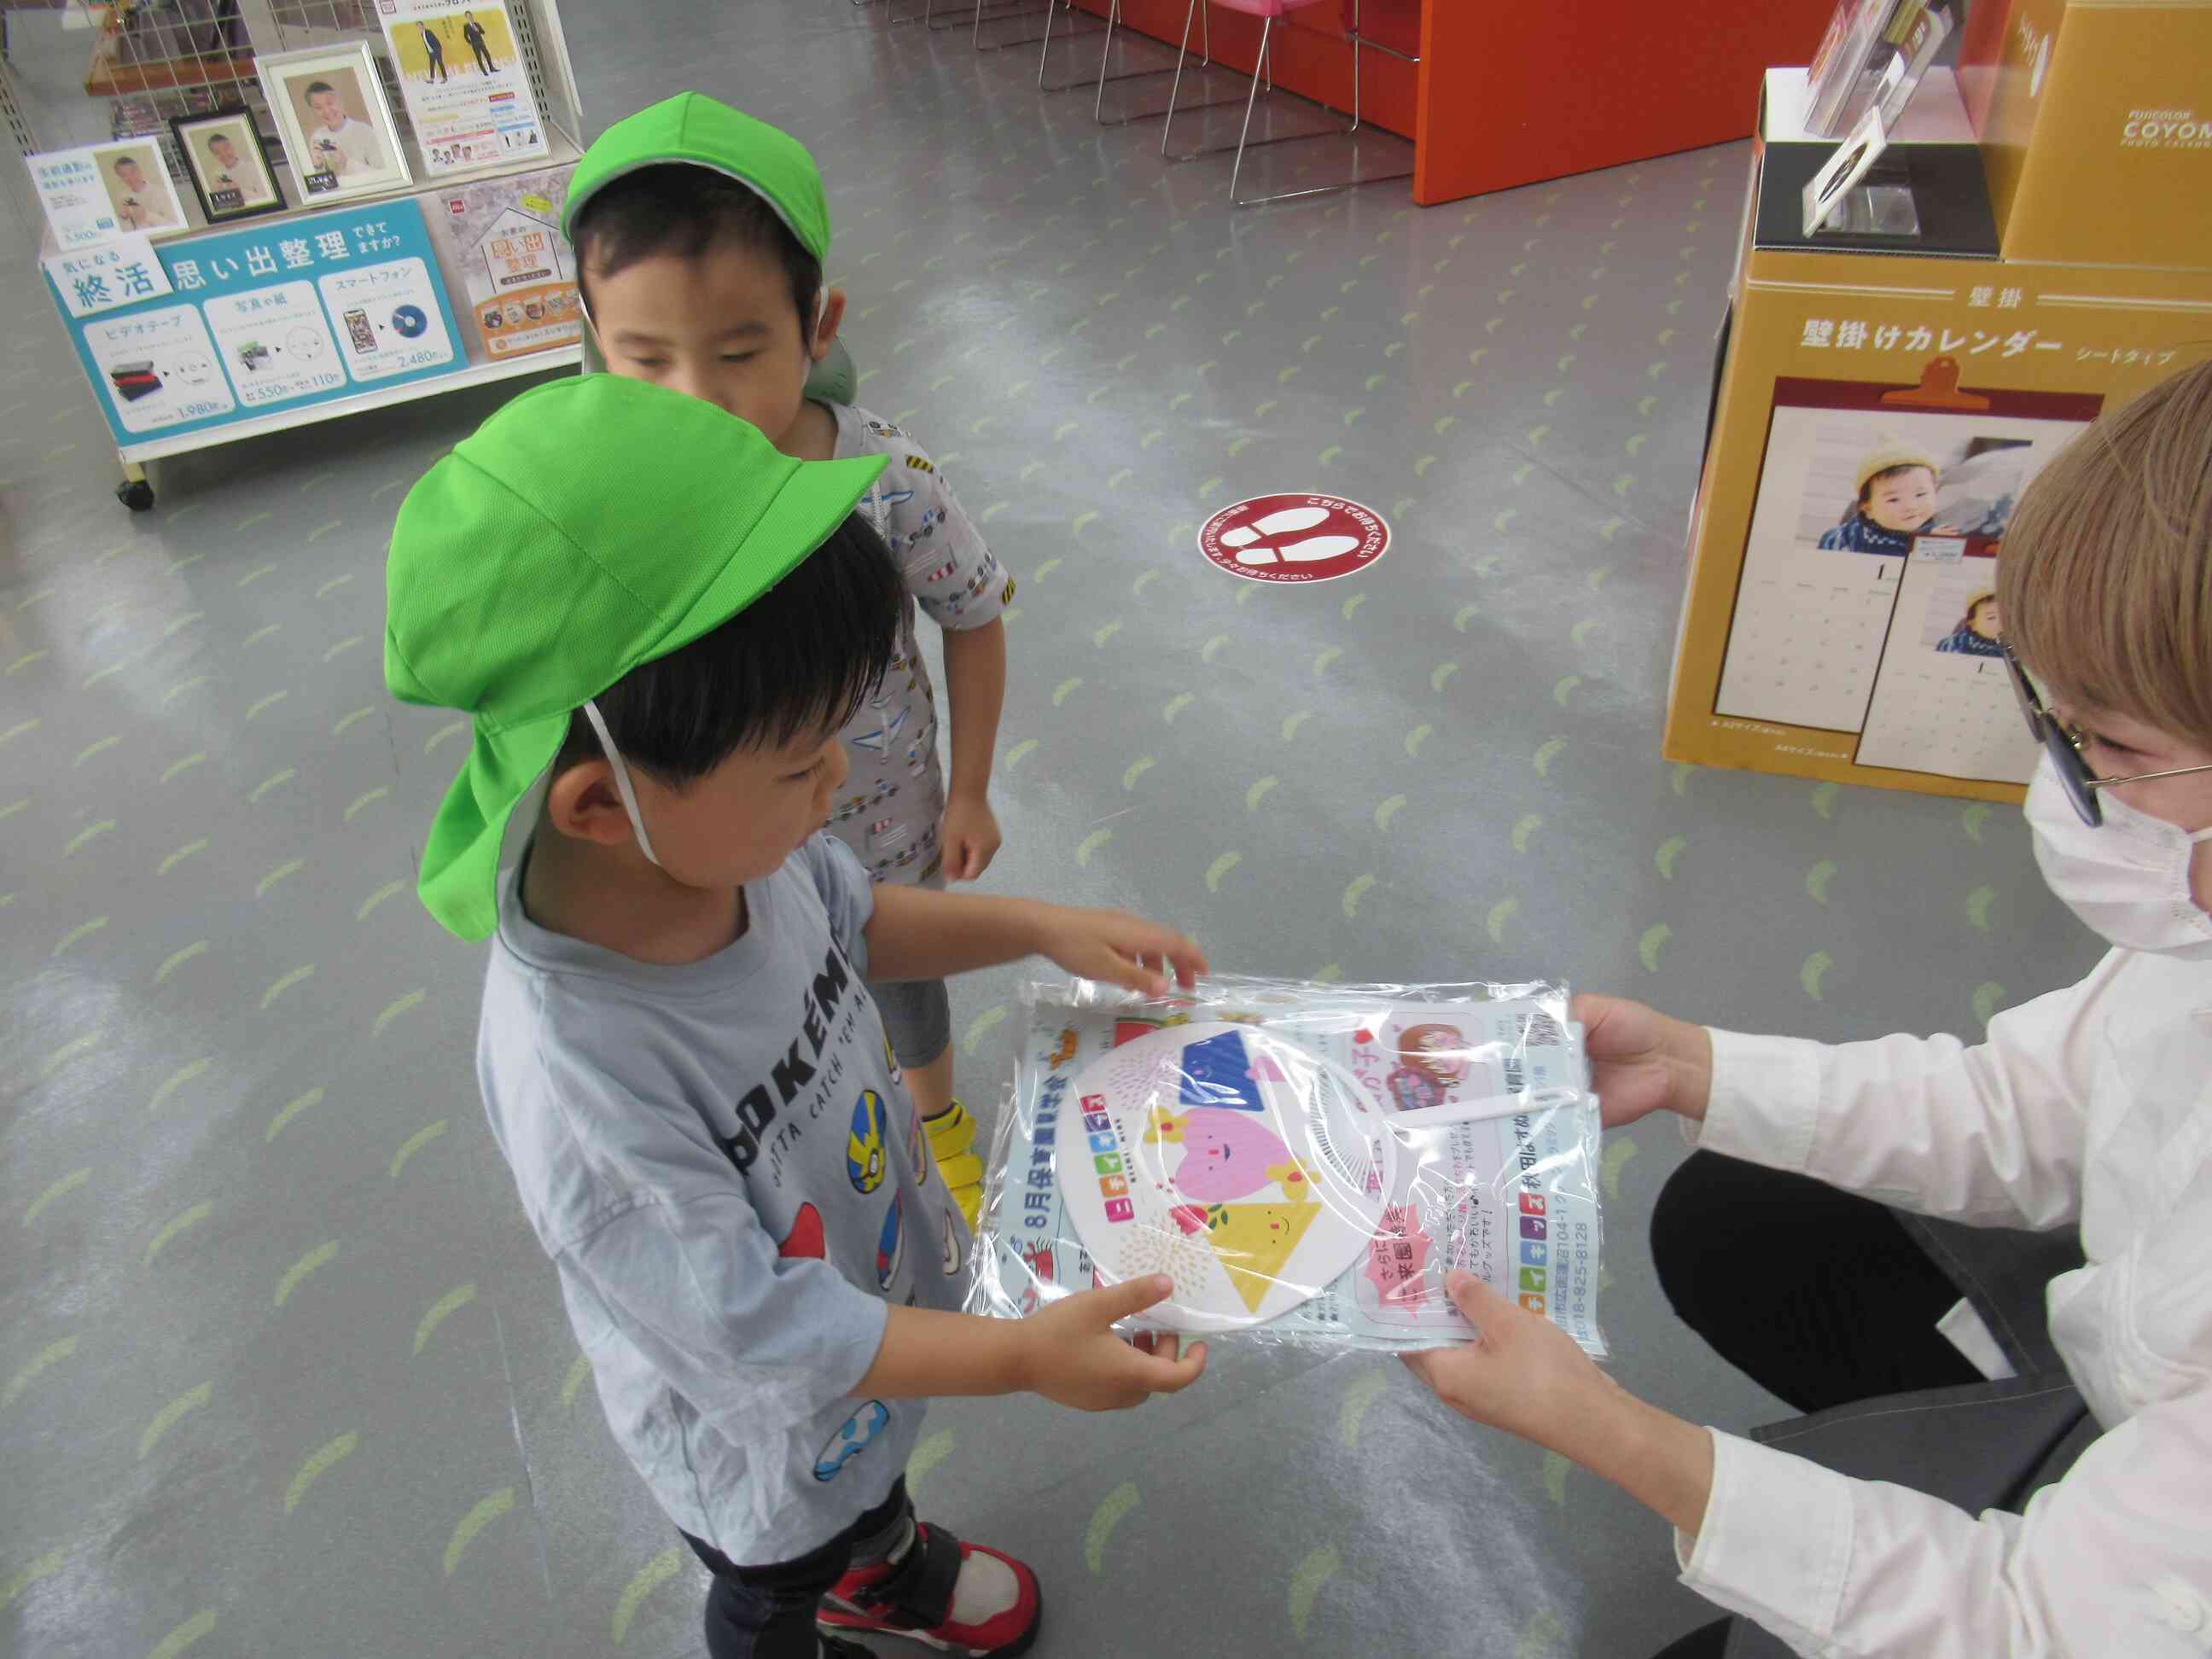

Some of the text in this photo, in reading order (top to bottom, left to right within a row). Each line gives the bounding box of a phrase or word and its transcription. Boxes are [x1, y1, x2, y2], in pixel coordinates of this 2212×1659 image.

[352, 221, 387, 239] できて
[62, 250, 121, 276] 気になる
[172, 230, 350, 291] 思い出整理
[336, 267, 412, 291] スマートフォン
[73, 262, 154, 308] 終活
[1968, 286, 2022, 309] 壁掛
[105, 314, 184, 341] ビデオテープ
[1802, 319, 2178, 365] 壁掛けカレンダー シートタイプ
[1307, 497, 1382, 559] こちらでお待ちください
[721, 932, 852, 1177] POKÉM
[810, 1051, 844, 1120] CATCH
[1023, 1074, 1068, 1230] 8月保育園見学会
[1080, 1093, 1135, 1223] ニチイキッズ
